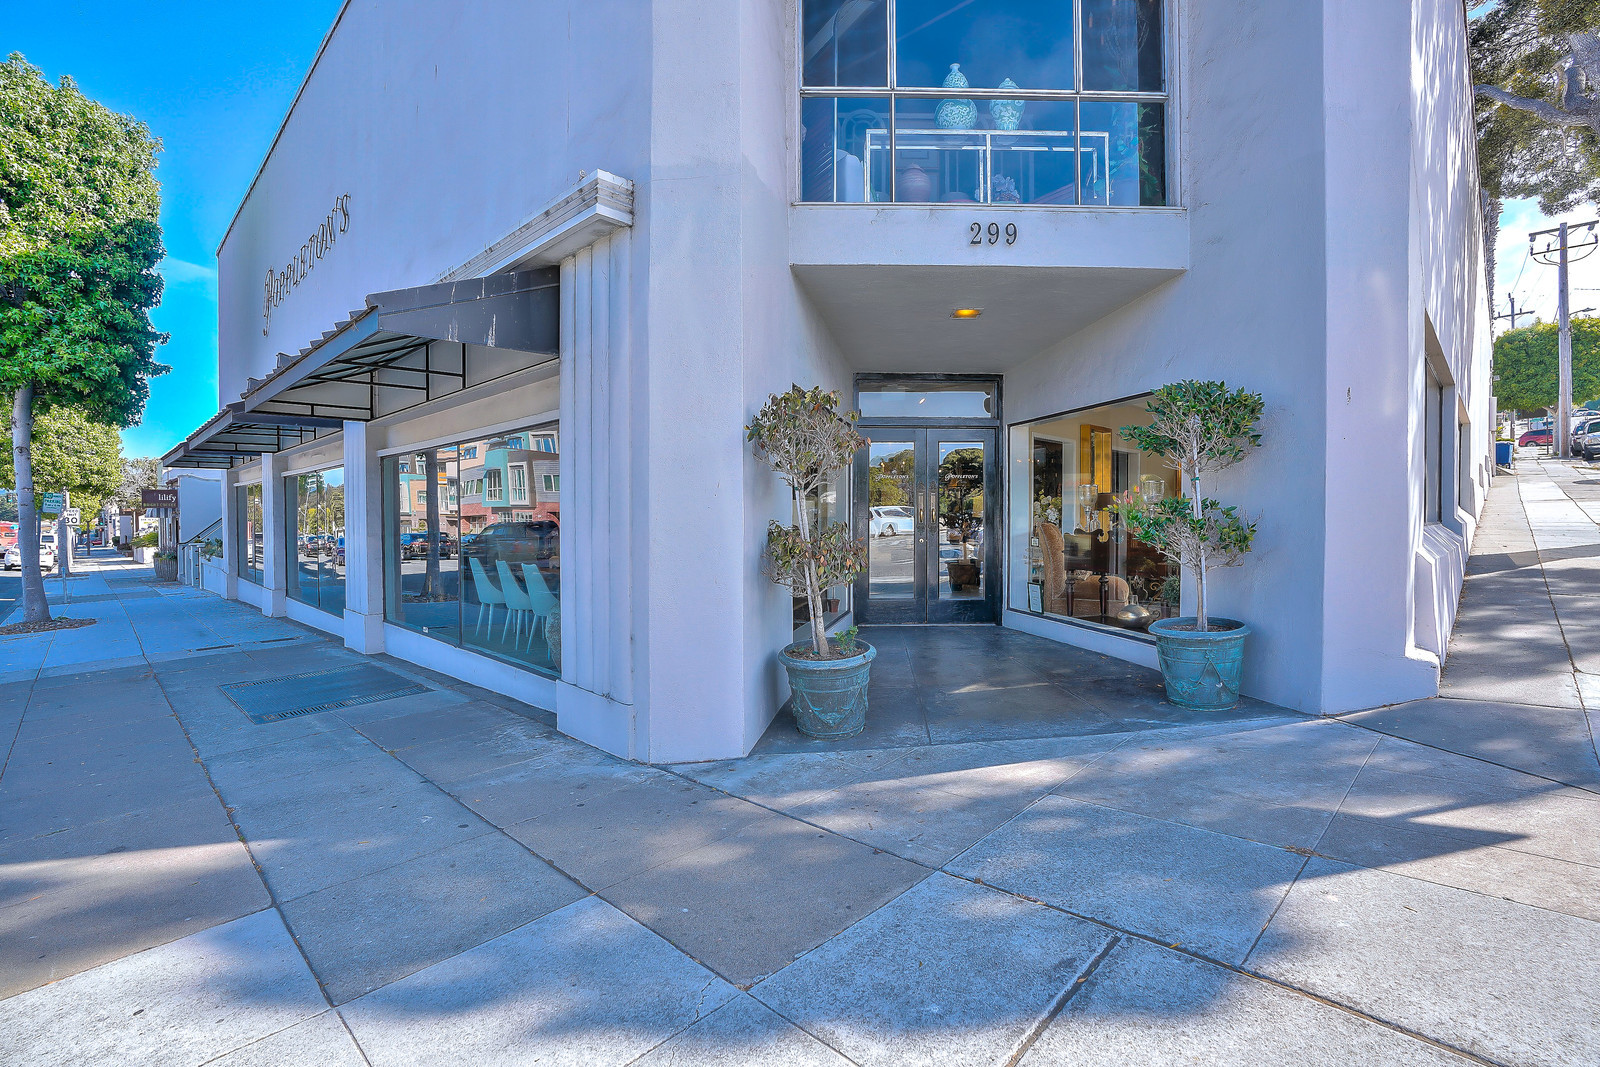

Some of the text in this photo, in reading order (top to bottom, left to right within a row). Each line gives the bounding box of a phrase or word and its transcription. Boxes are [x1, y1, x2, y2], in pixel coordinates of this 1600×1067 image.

[970, 222, 1018, 246] 299
[158, 493, 177, 503] lilify
[65, 516, 78, 524] 30
